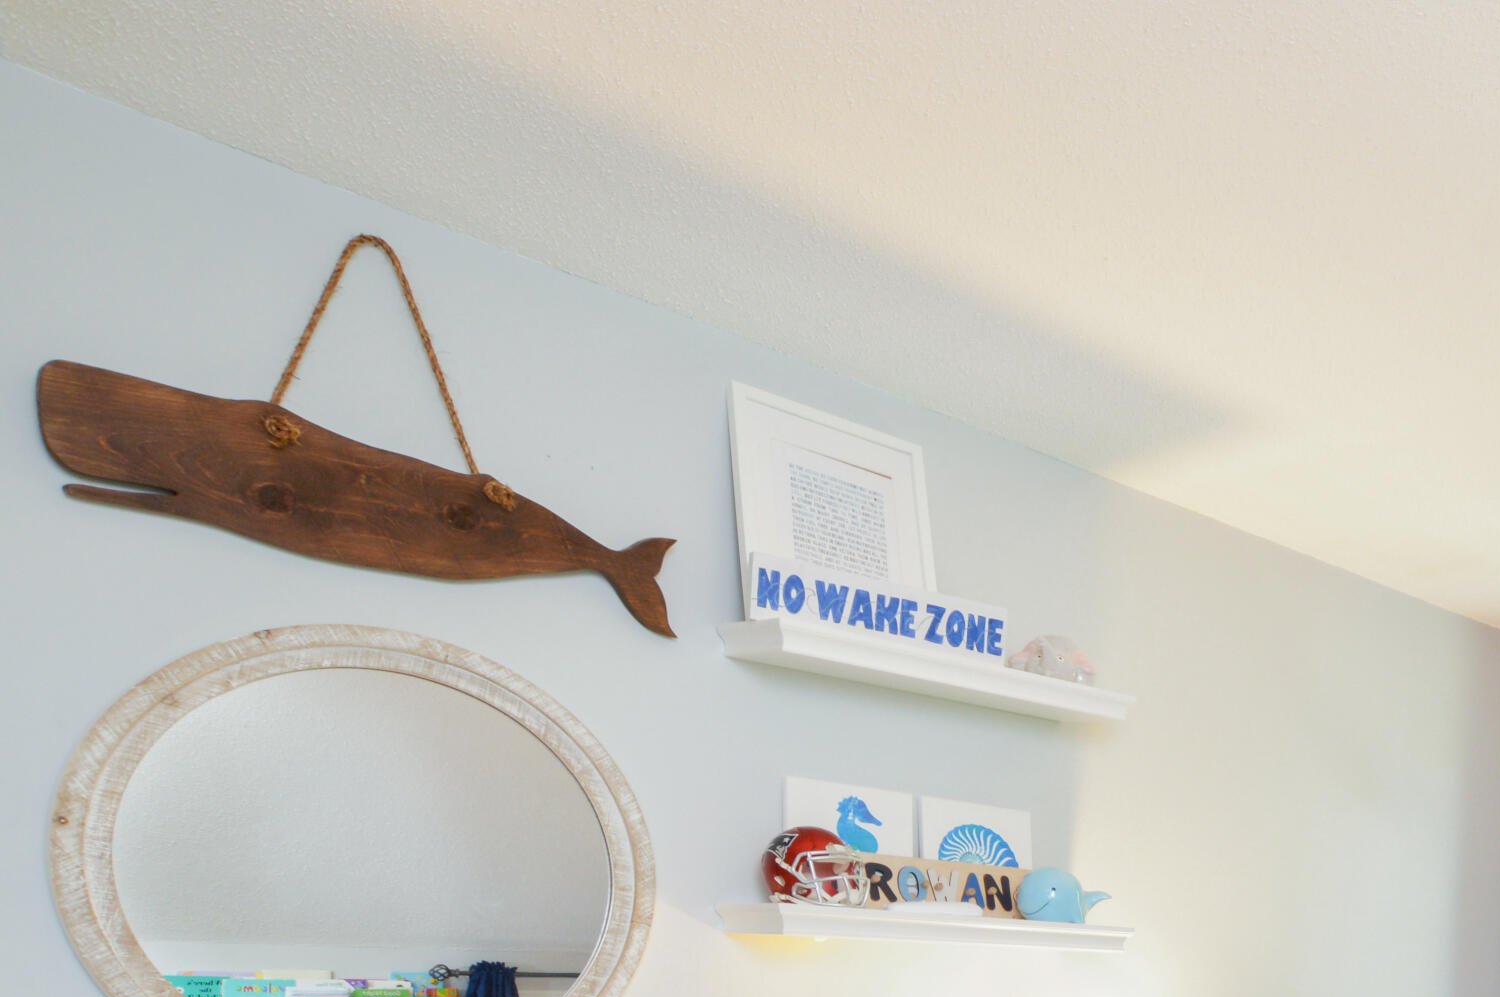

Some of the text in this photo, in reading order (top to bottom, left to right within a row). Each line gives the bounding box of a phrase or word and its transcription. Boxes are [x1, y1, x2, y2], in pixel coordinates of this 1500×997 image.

[756, 568, 1004, 657] NO WAKE ZONE
[865, 862, 1014, 912] ROWAN
